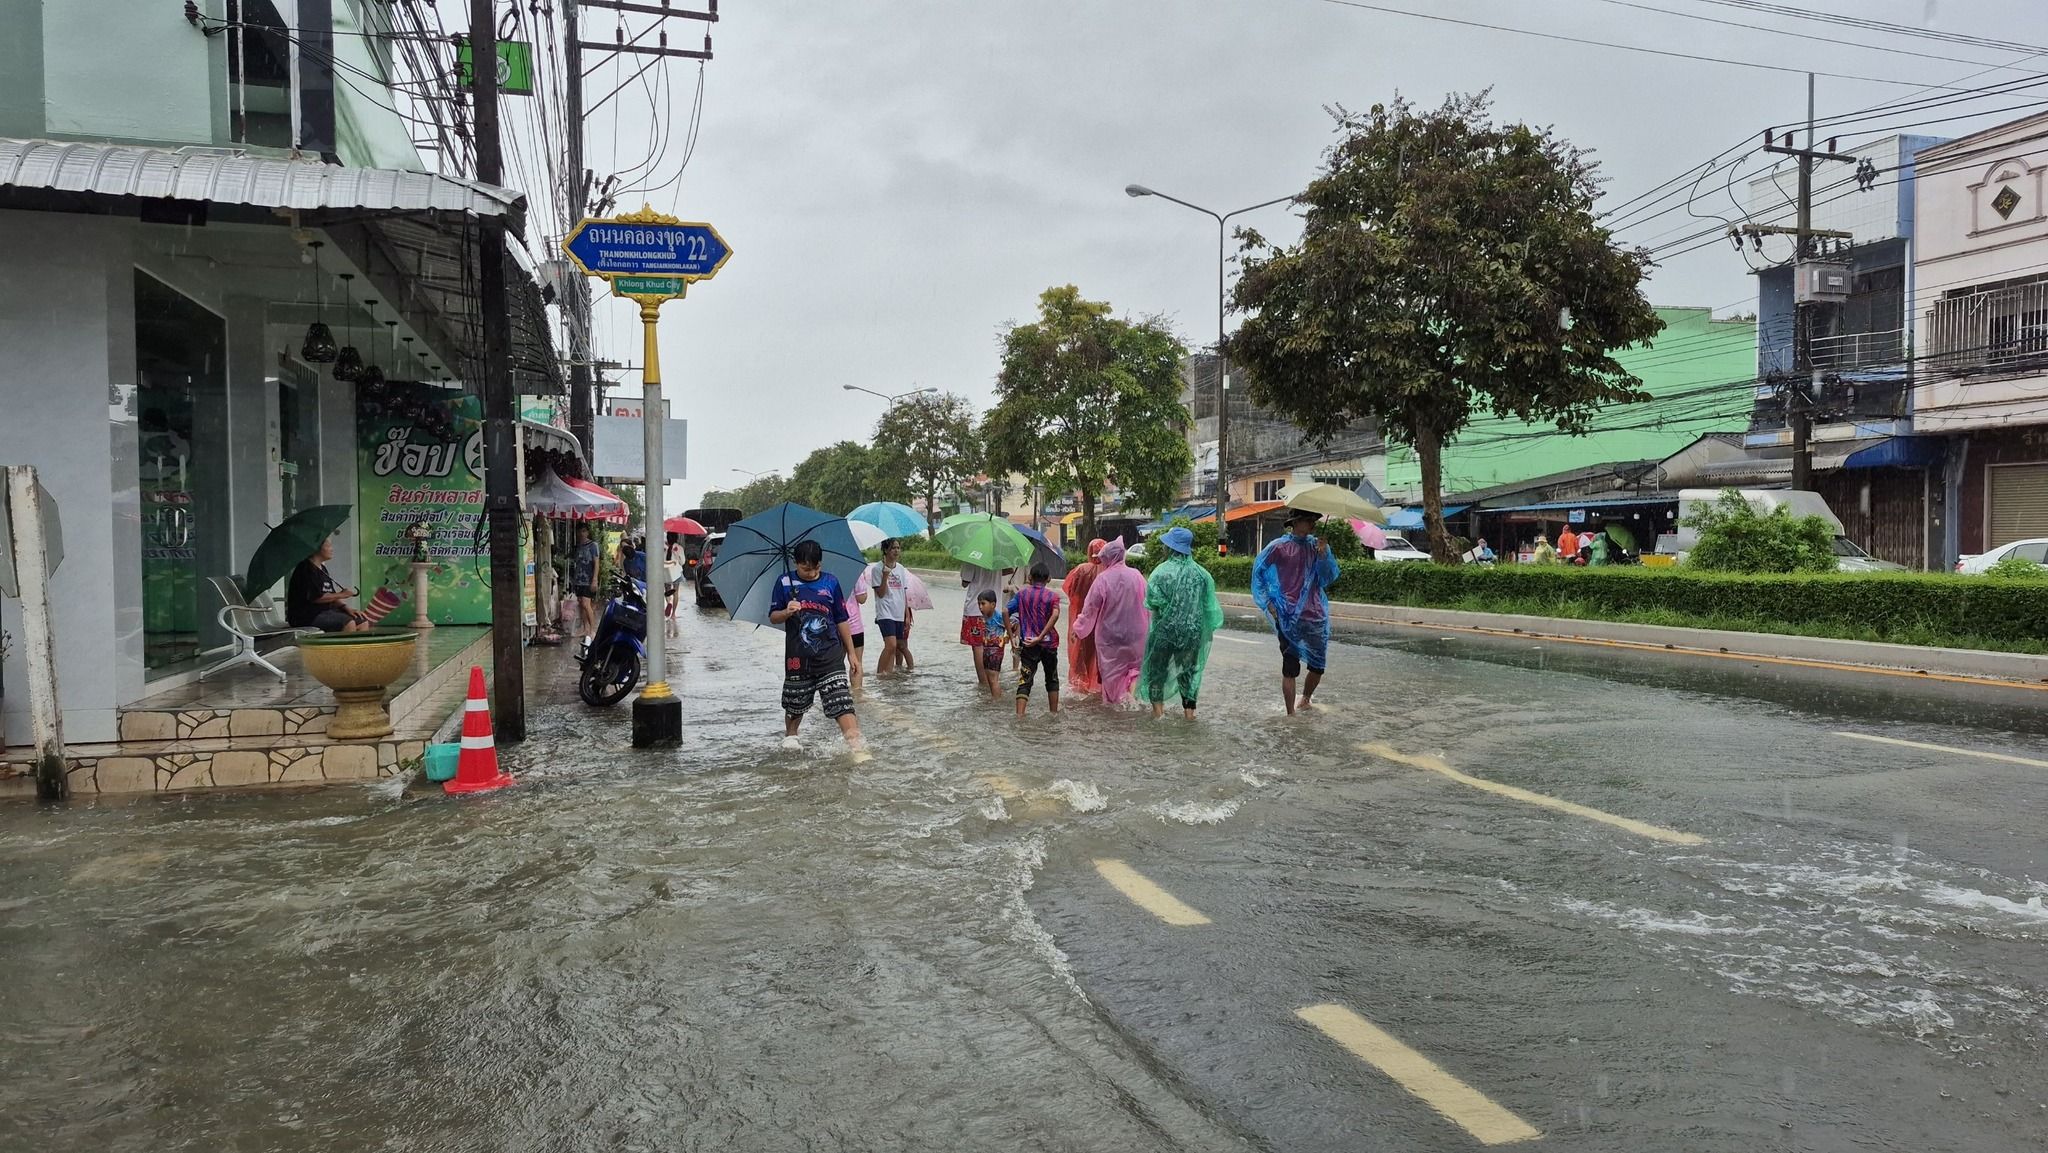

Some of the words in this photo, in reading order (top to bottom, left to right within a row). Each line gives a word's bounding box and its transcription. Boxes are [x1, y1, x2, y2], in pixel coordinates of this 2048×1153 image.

[588, 228, 685, 251] ถนนคลองขุด
[687, 236, 708, 260] 22
[618, 280, 644, 290] Khlong
[646, 281, 665, 289] Khud
[388, 483, 484, 505] สินค้าพลาส
